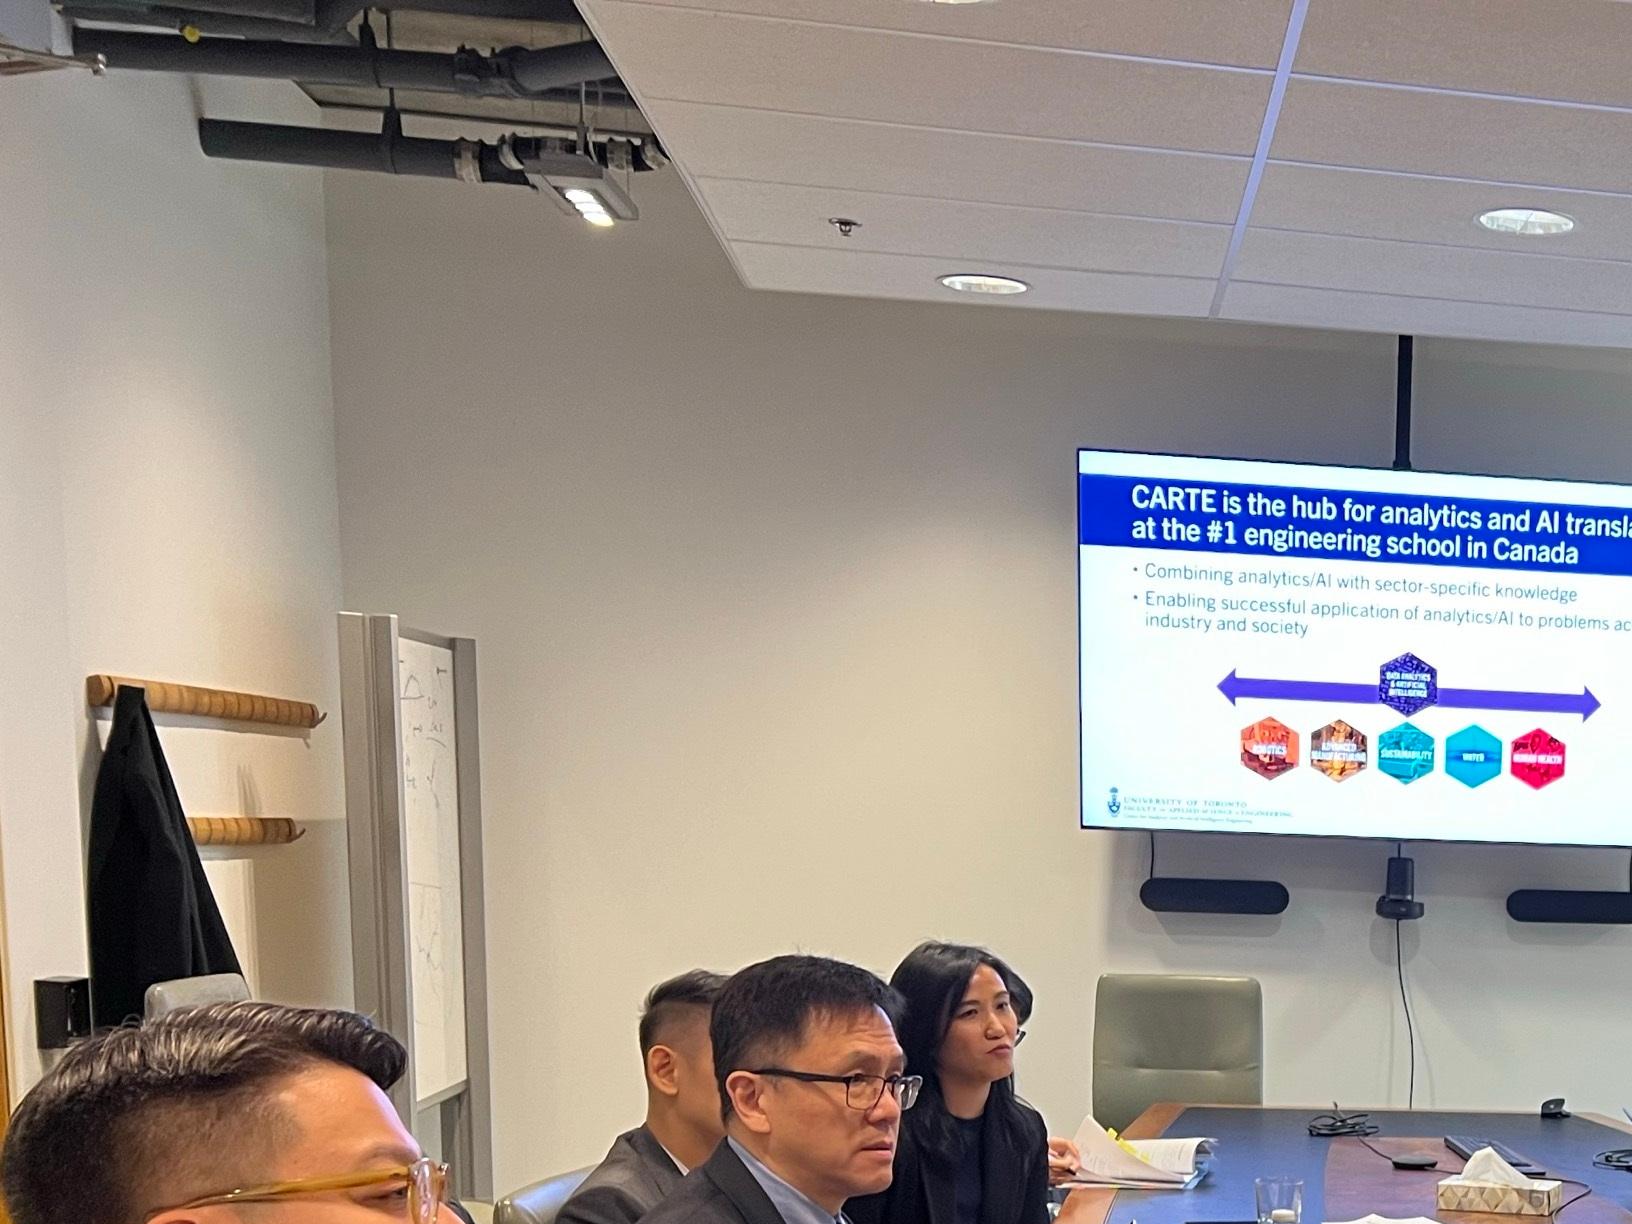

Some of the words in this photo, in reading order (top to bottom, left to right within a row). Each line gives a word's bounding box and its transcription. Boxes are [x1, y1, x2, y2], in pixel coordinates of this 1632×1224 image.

[1131, 484, 1217, 513] CARTE
[1222, 490, 1242, 514] is
[1247, 492, 1286, 518] the
[1291, 494, 1338, 521] hub
[1342, 497, 1375, 522] for
[1380, 502, 1482, 531] analytics
[1487, 508, 1531, 532] and
[1535, 510, 1560, 534] AI
[1131, 516, 1156, 540] at
[1161, 517, 1201, 542] the
[1206, 520, 1237, 545] #1
[1244, 525, 1381, 557] engineering
[1386, 532, 1461, 557] school
[1466, 535, 1487, 559] in
[1493, 537, 1579, 565] Canada
[1145, 562, 1234, 585] Combining
[1238, 569, 1332, 589] analytics/AI
[1336, 573, 1370, 591] with
[1375, 575, 1490, 597] sector-specific
[1495, 582, 1578, 604] knowledge
[1145, 590, 1217, 612] Enabling
[1221, 596, 1306, 615] successful
[1311, 601, 1399, 620] application
[1404, 605, 1419, 621] of
[1423, 608, 1514, 627] analytics/AI
[1519, 611, 1534, 626] to
[1538, 613, 1610, 631] problems
[1145, 613, 1212, 633] industry
[1216, 617, 1247, 632] and
[1251, 619, 1309, 638] society
[1123, 796, 1182, 806] UNIVERSITY
[1203, 800, 1248, 809] TORONTO
